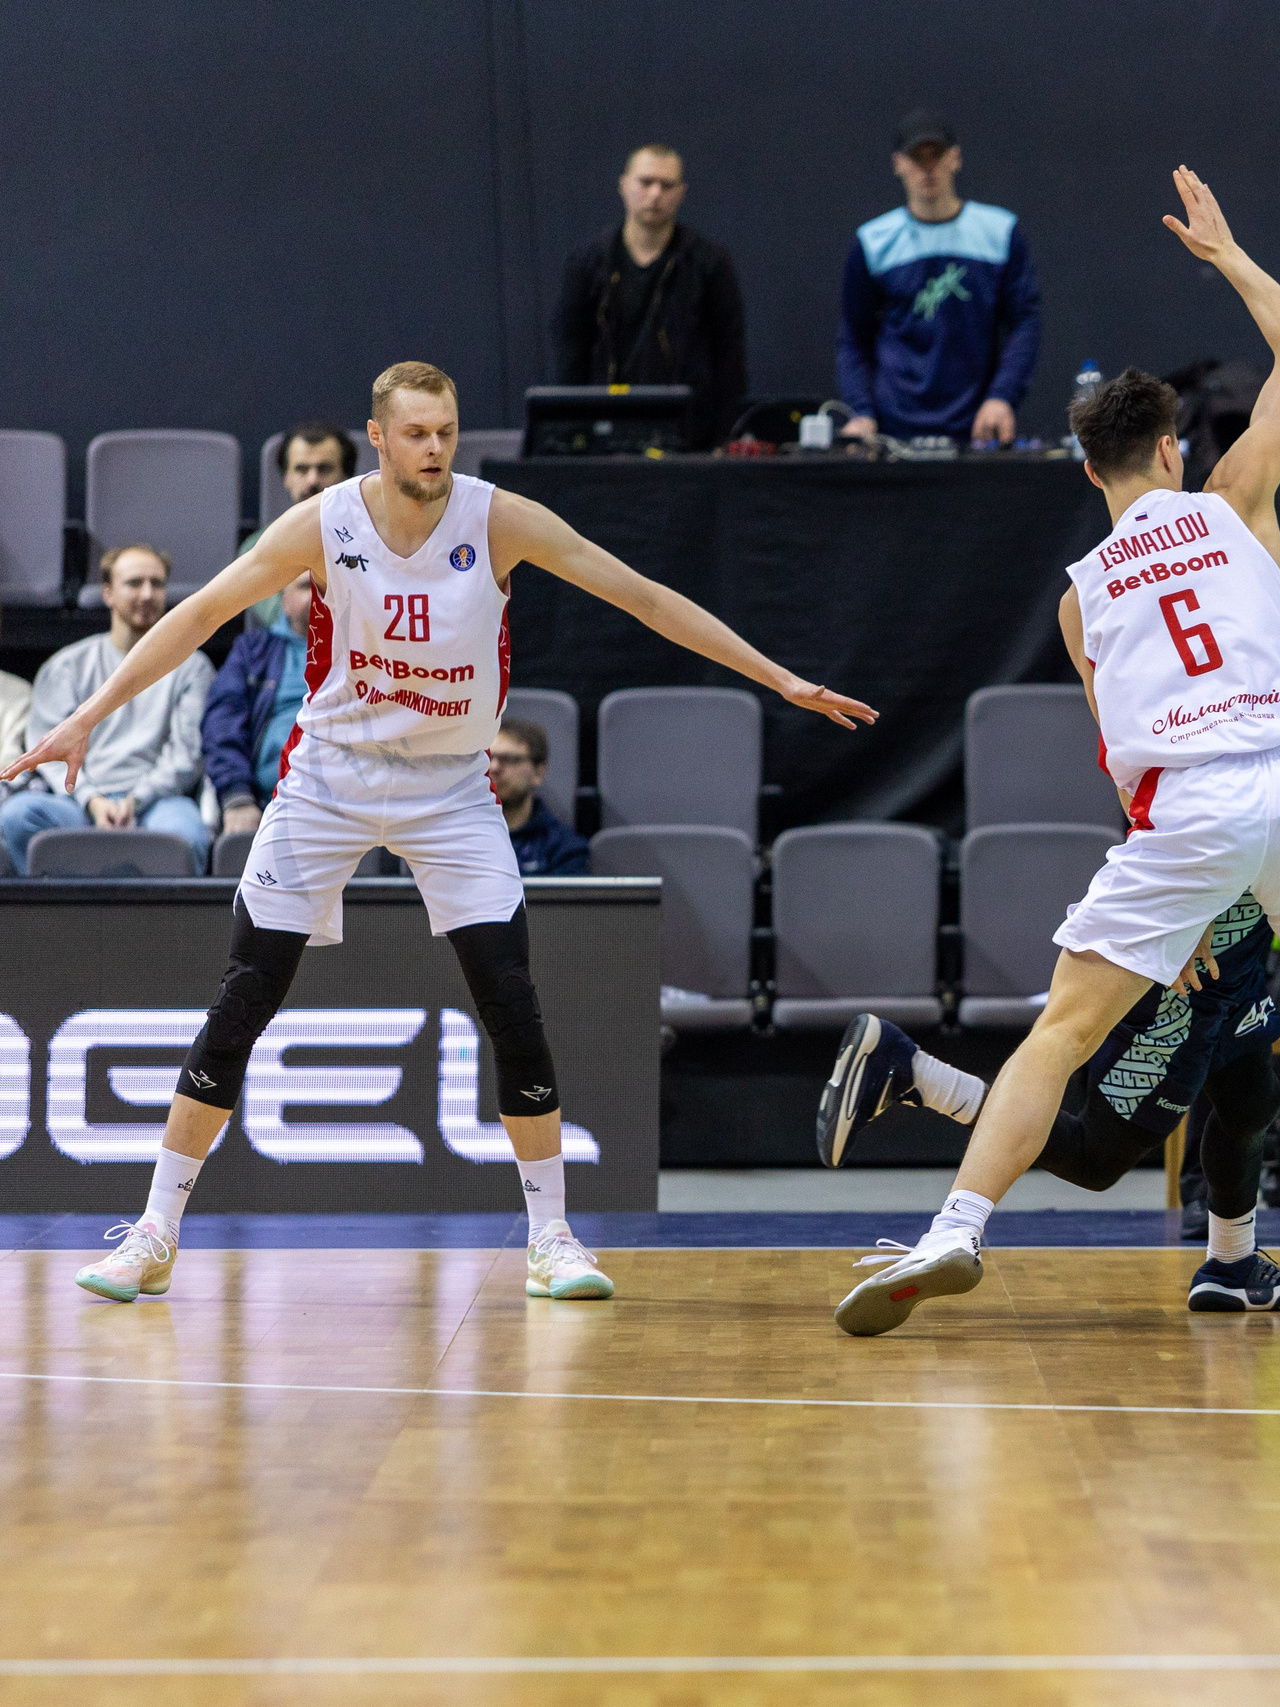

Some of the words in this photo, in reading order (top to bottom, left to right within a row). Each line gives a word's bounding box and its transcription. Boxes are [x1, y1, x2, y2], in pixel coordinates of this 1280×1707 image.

[1097, 511, 1209, 572] ISMAILOV
[1106, 550, 1229, 600] BetBoom
[384, 594, 430, 642] 28
[1158, 588, 1223, 677] 6
[350, 649, 475, 684] BetBoom
[0, 1008, 600, 1165] GEL
